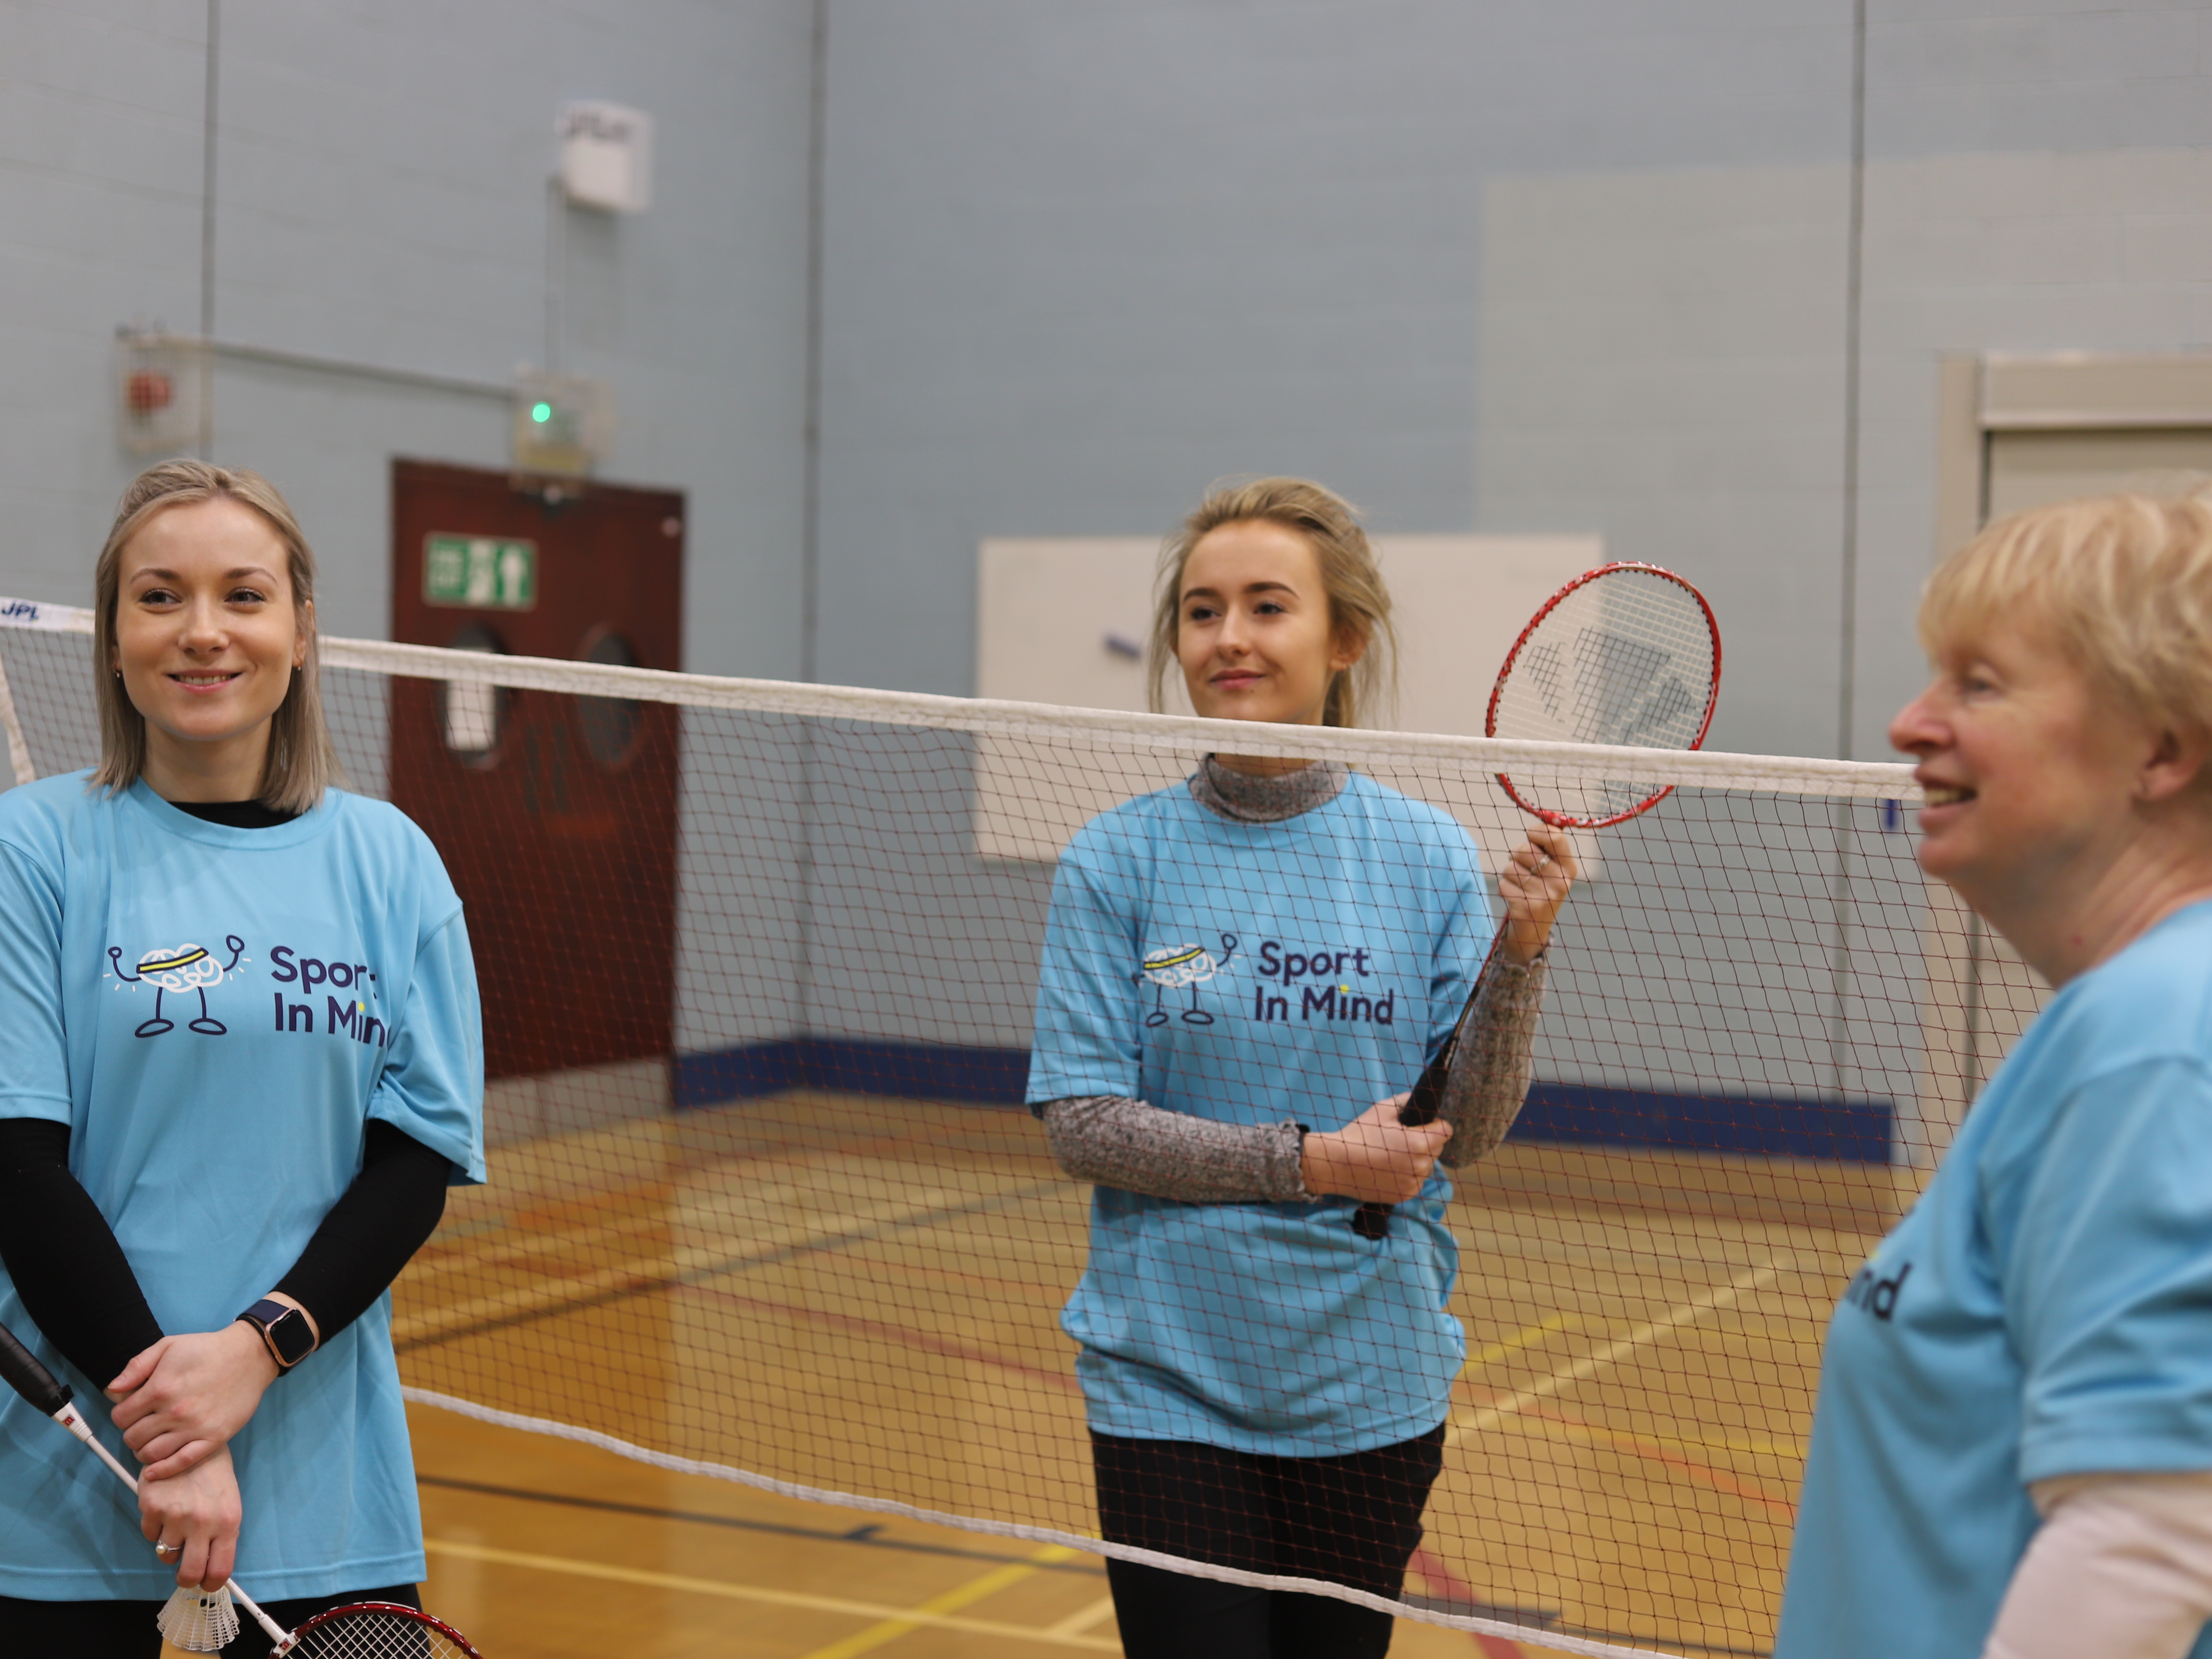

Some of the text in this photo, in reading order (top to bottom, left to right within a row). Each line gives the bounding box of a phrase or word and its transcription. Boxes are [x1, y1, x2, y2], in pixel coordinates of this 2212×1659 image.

[2, 602, 39, 620] JPL
[1258, 941, 1369, 986] Sport
[274, 993, 390, 1049] In Min
[1255, 984, 1394, 1025] In Mind
[1846, 1261, 1913, 1323] nd
